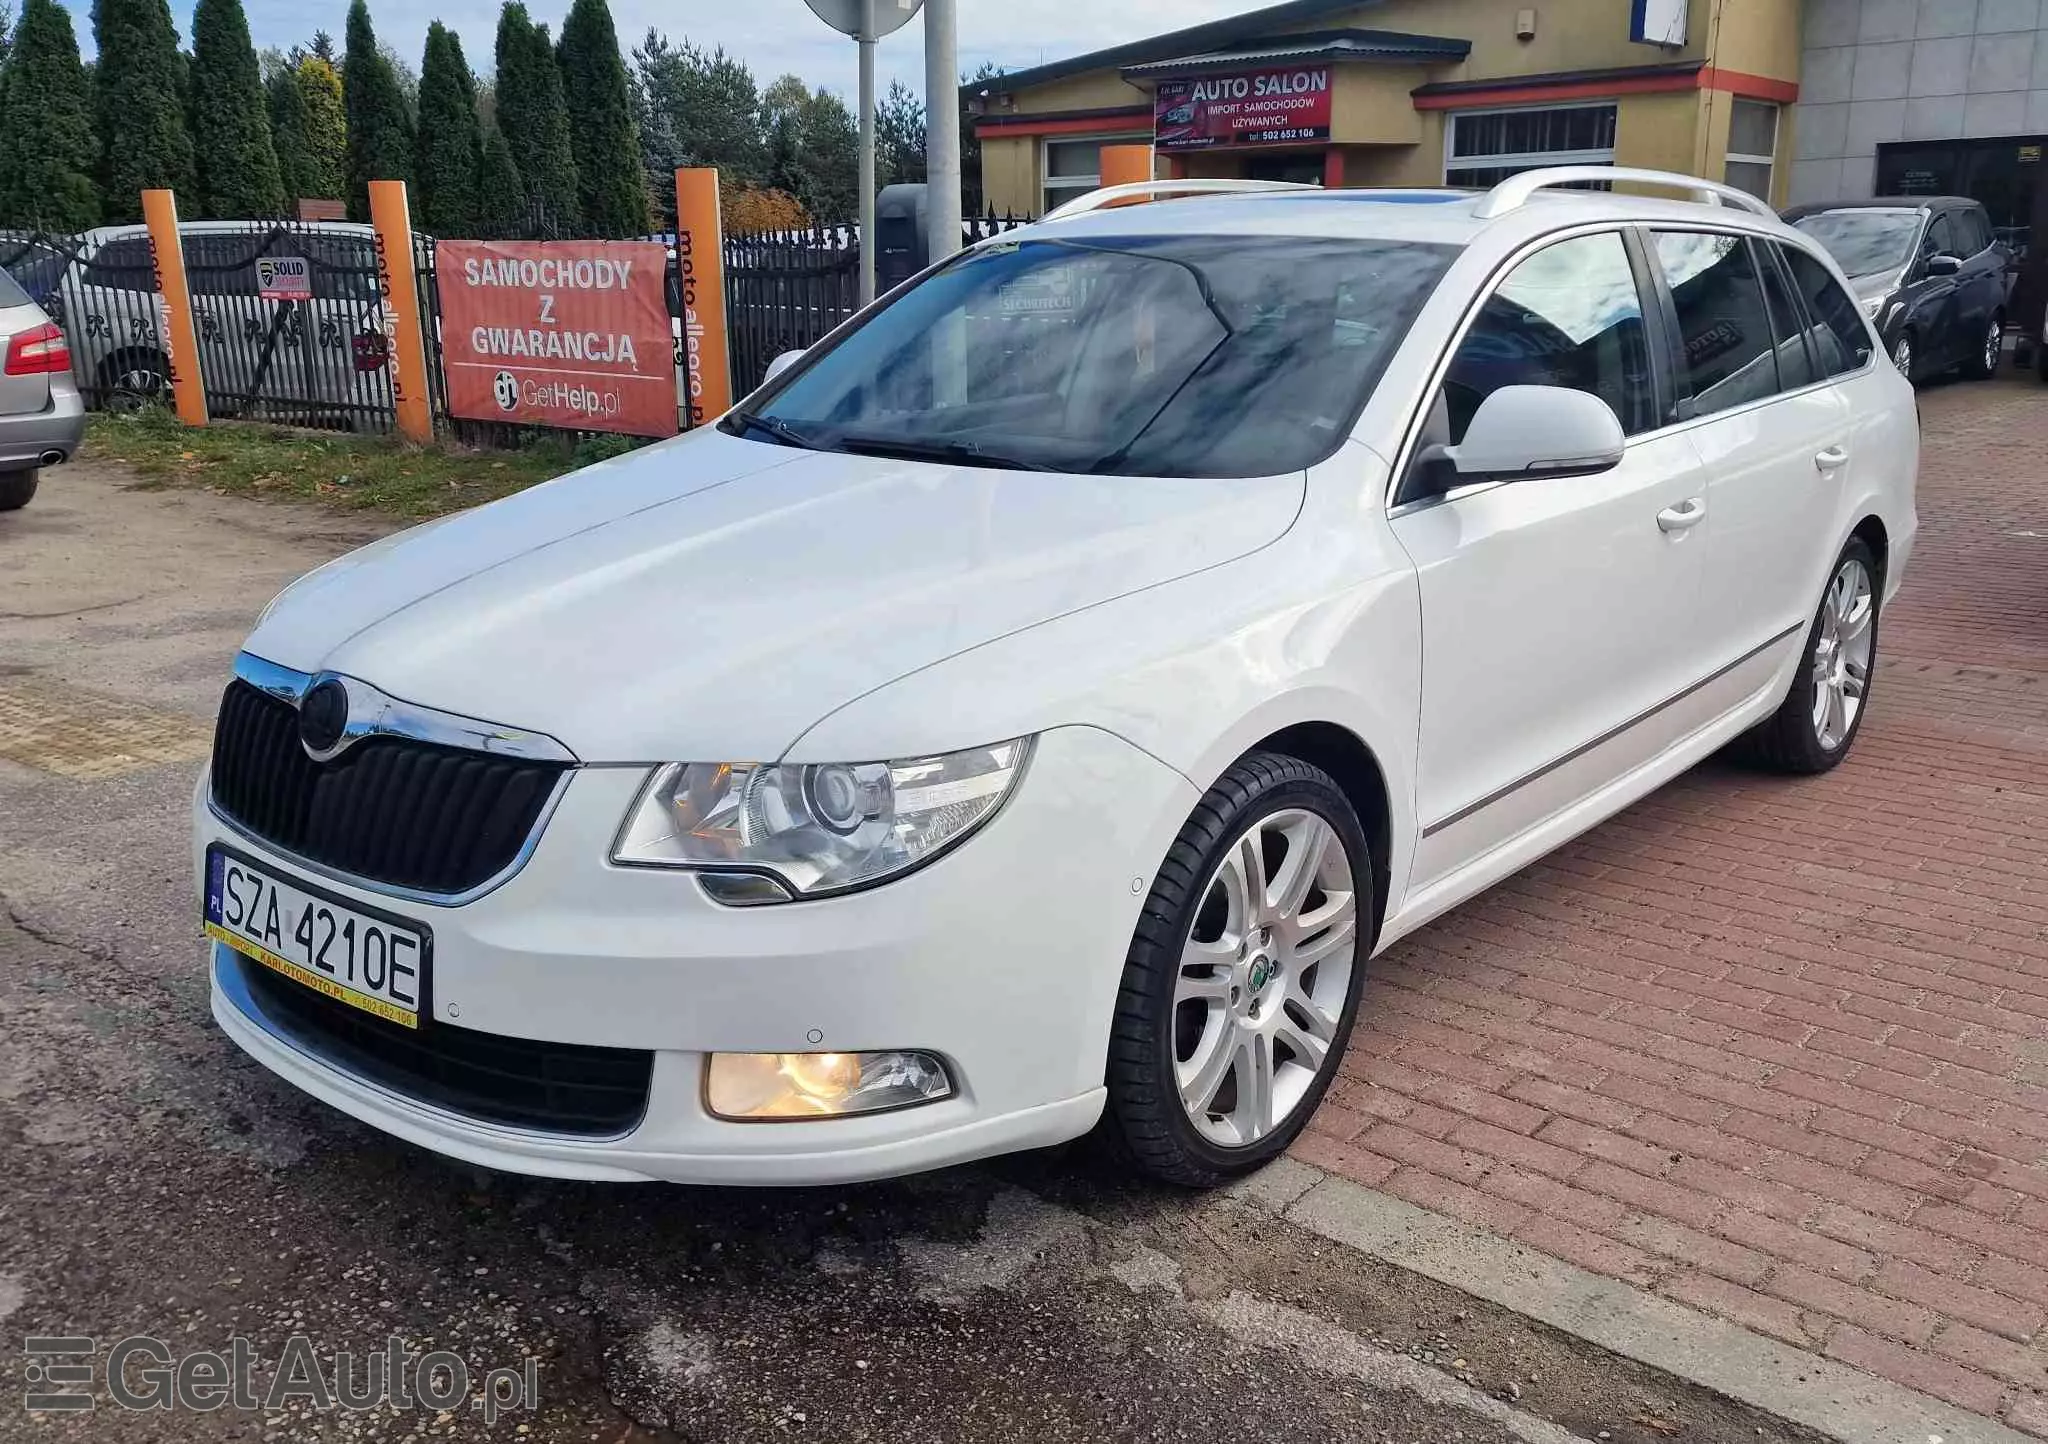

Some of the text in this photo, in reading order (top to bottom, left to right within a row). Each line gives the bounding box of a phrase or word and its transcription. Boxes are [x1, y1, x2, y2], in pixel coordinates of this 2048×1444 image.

[1191, 69, 1327, 101] AUTO SALON
[1207, 97, 1315, 116] IMPORT SAMOCHODÓW
[1232, 115, 1288, 129] UŻYWANYCH
[1262, 130, 1279, 141] 502
[1280, 129, 1297, 139] 652
[1298, 127, 1314, 139] 106
[273, 261, 304, 276] SOLID
[464, 257, 633, 291] SAMOCHODY
[538, 294, 557, 324] Z
[471, 326, 640, 372] GWARANCJĄ
[522, 379, 623, 420] GetHelp.pl
[211, 895, 222, 914] PL
[225, 866, 417, 1006] SZA 4210E
[260, 951, 346, 1001] KARI.OTOMOTO.PL
